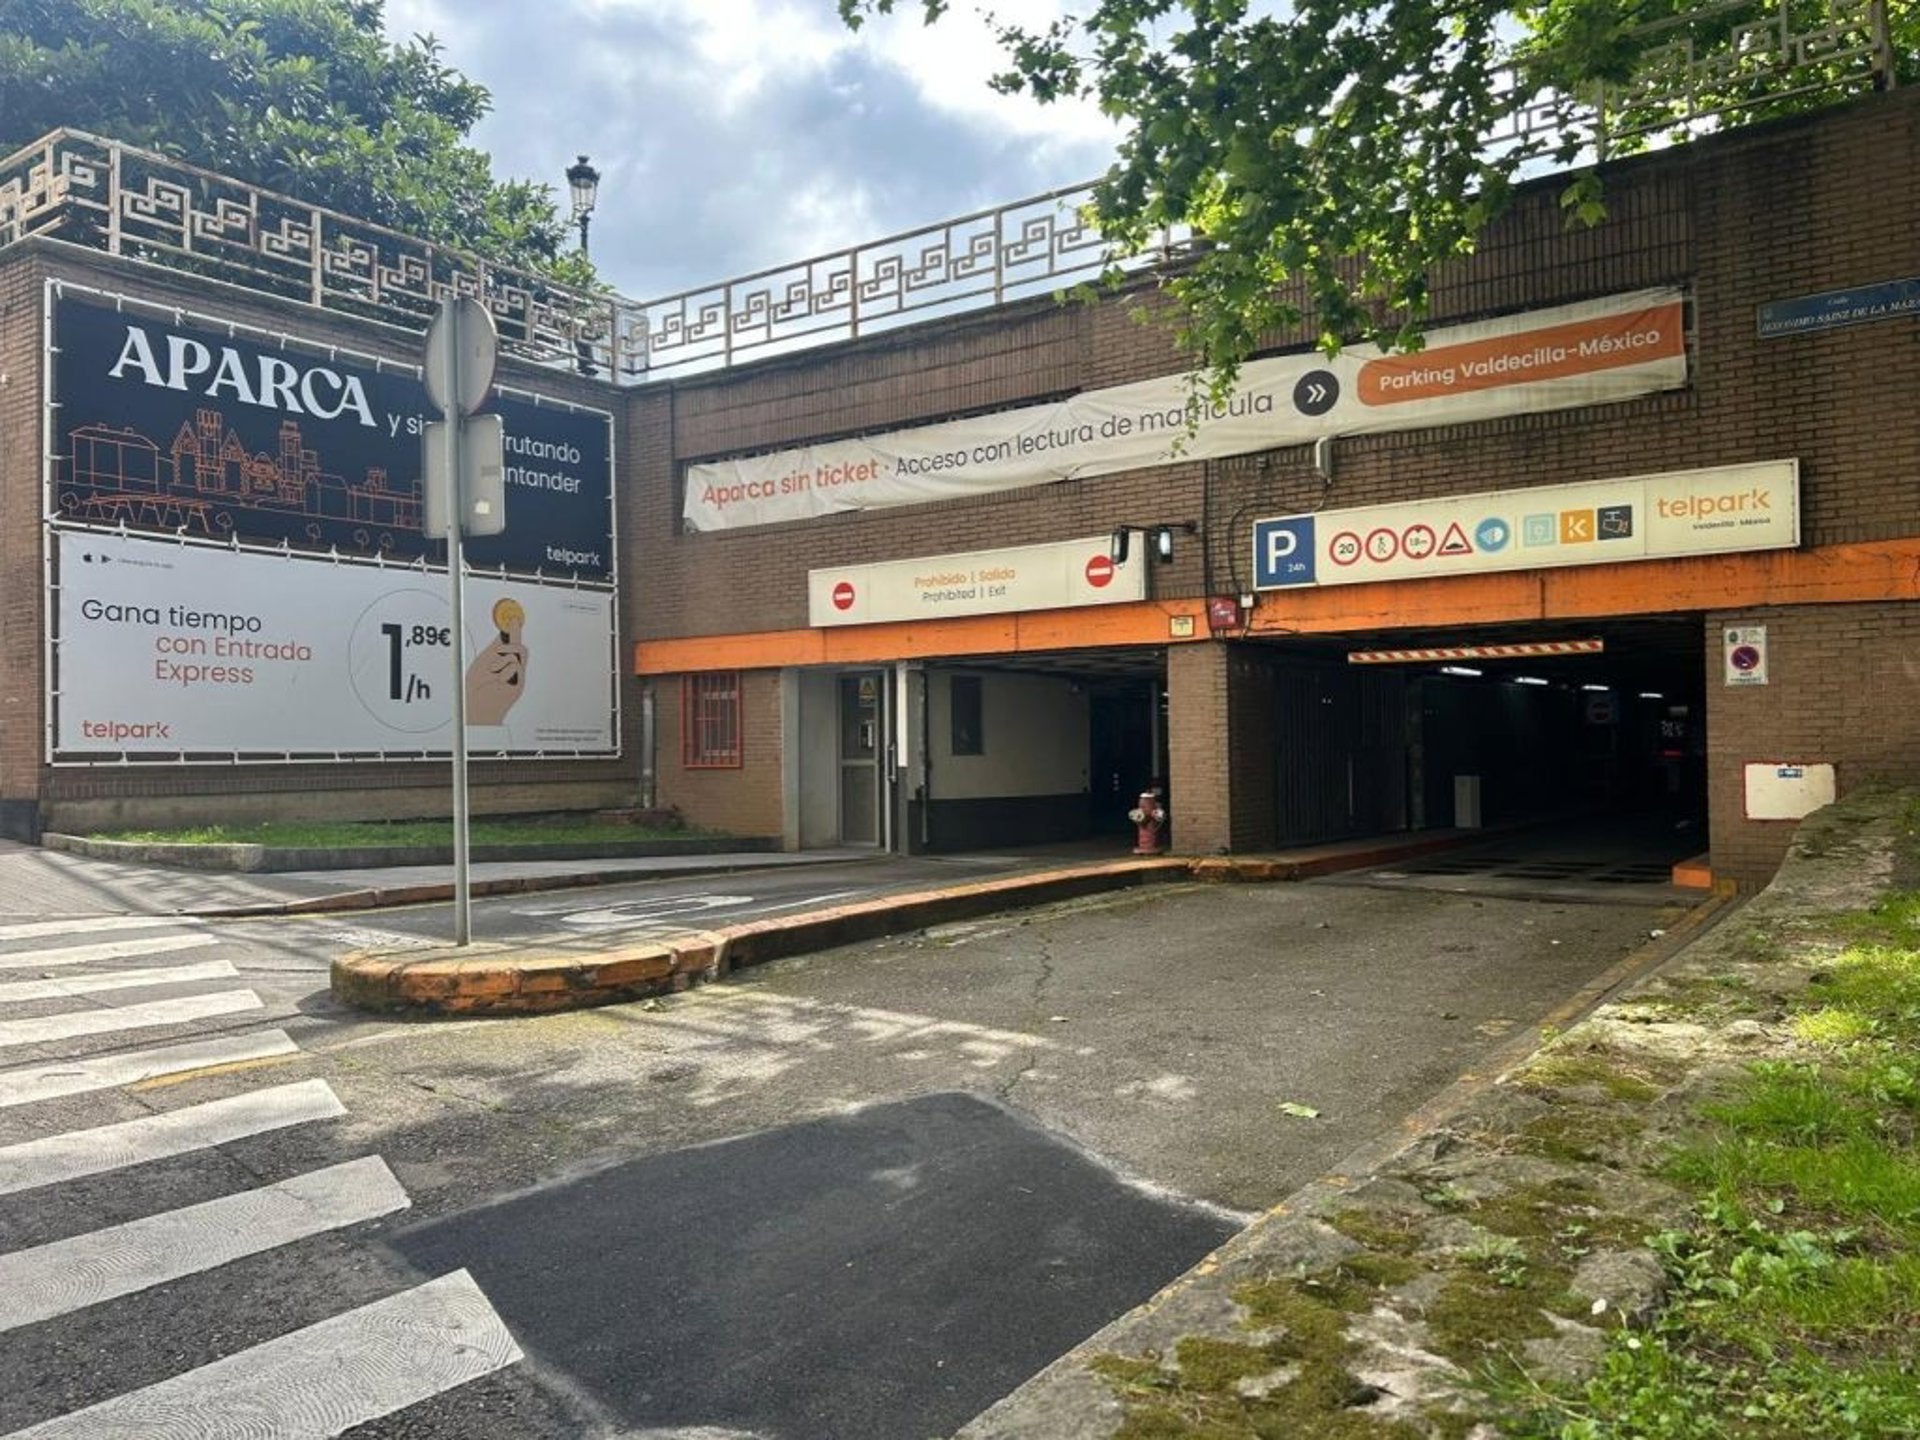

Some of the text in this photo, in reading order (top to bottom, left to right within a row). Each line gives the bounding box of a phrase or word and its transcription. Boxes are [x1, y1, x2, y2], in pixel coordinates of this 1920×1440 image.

[108, 325, 378, 427] APARCA
[1379, 330, 1661, 392] Parking Valdecilla-México
[386, 412, 400, 438] y
[701, 479, 777, 511] Aparca
[780, 469, 812, 495] sin
[815, 458, 879, 488] ticket
[895, 450, 968, 477] Acceso
[972, 439, 1011, 466] con
[1017, 425, 1093, 456] lectura
[1099, 414, 1133, 439] de
[1657, 488, 1771, 519] telpark
[546, 546, 600, 566] telpark
[1267, 530, 1297, 574] P
[1338, 543, 1355, 555] 20
[1287, 563, 1306, 573] 24h
[81, 599, 262, 636] Gana tiempo
[156, 636, 312, 661] con Entrada
[381, 623, 402, 700] 1
[155, 659, 254, 687] Express
[405, 673, 431, 704] /h
[82, 719, 169, 742] telpark
